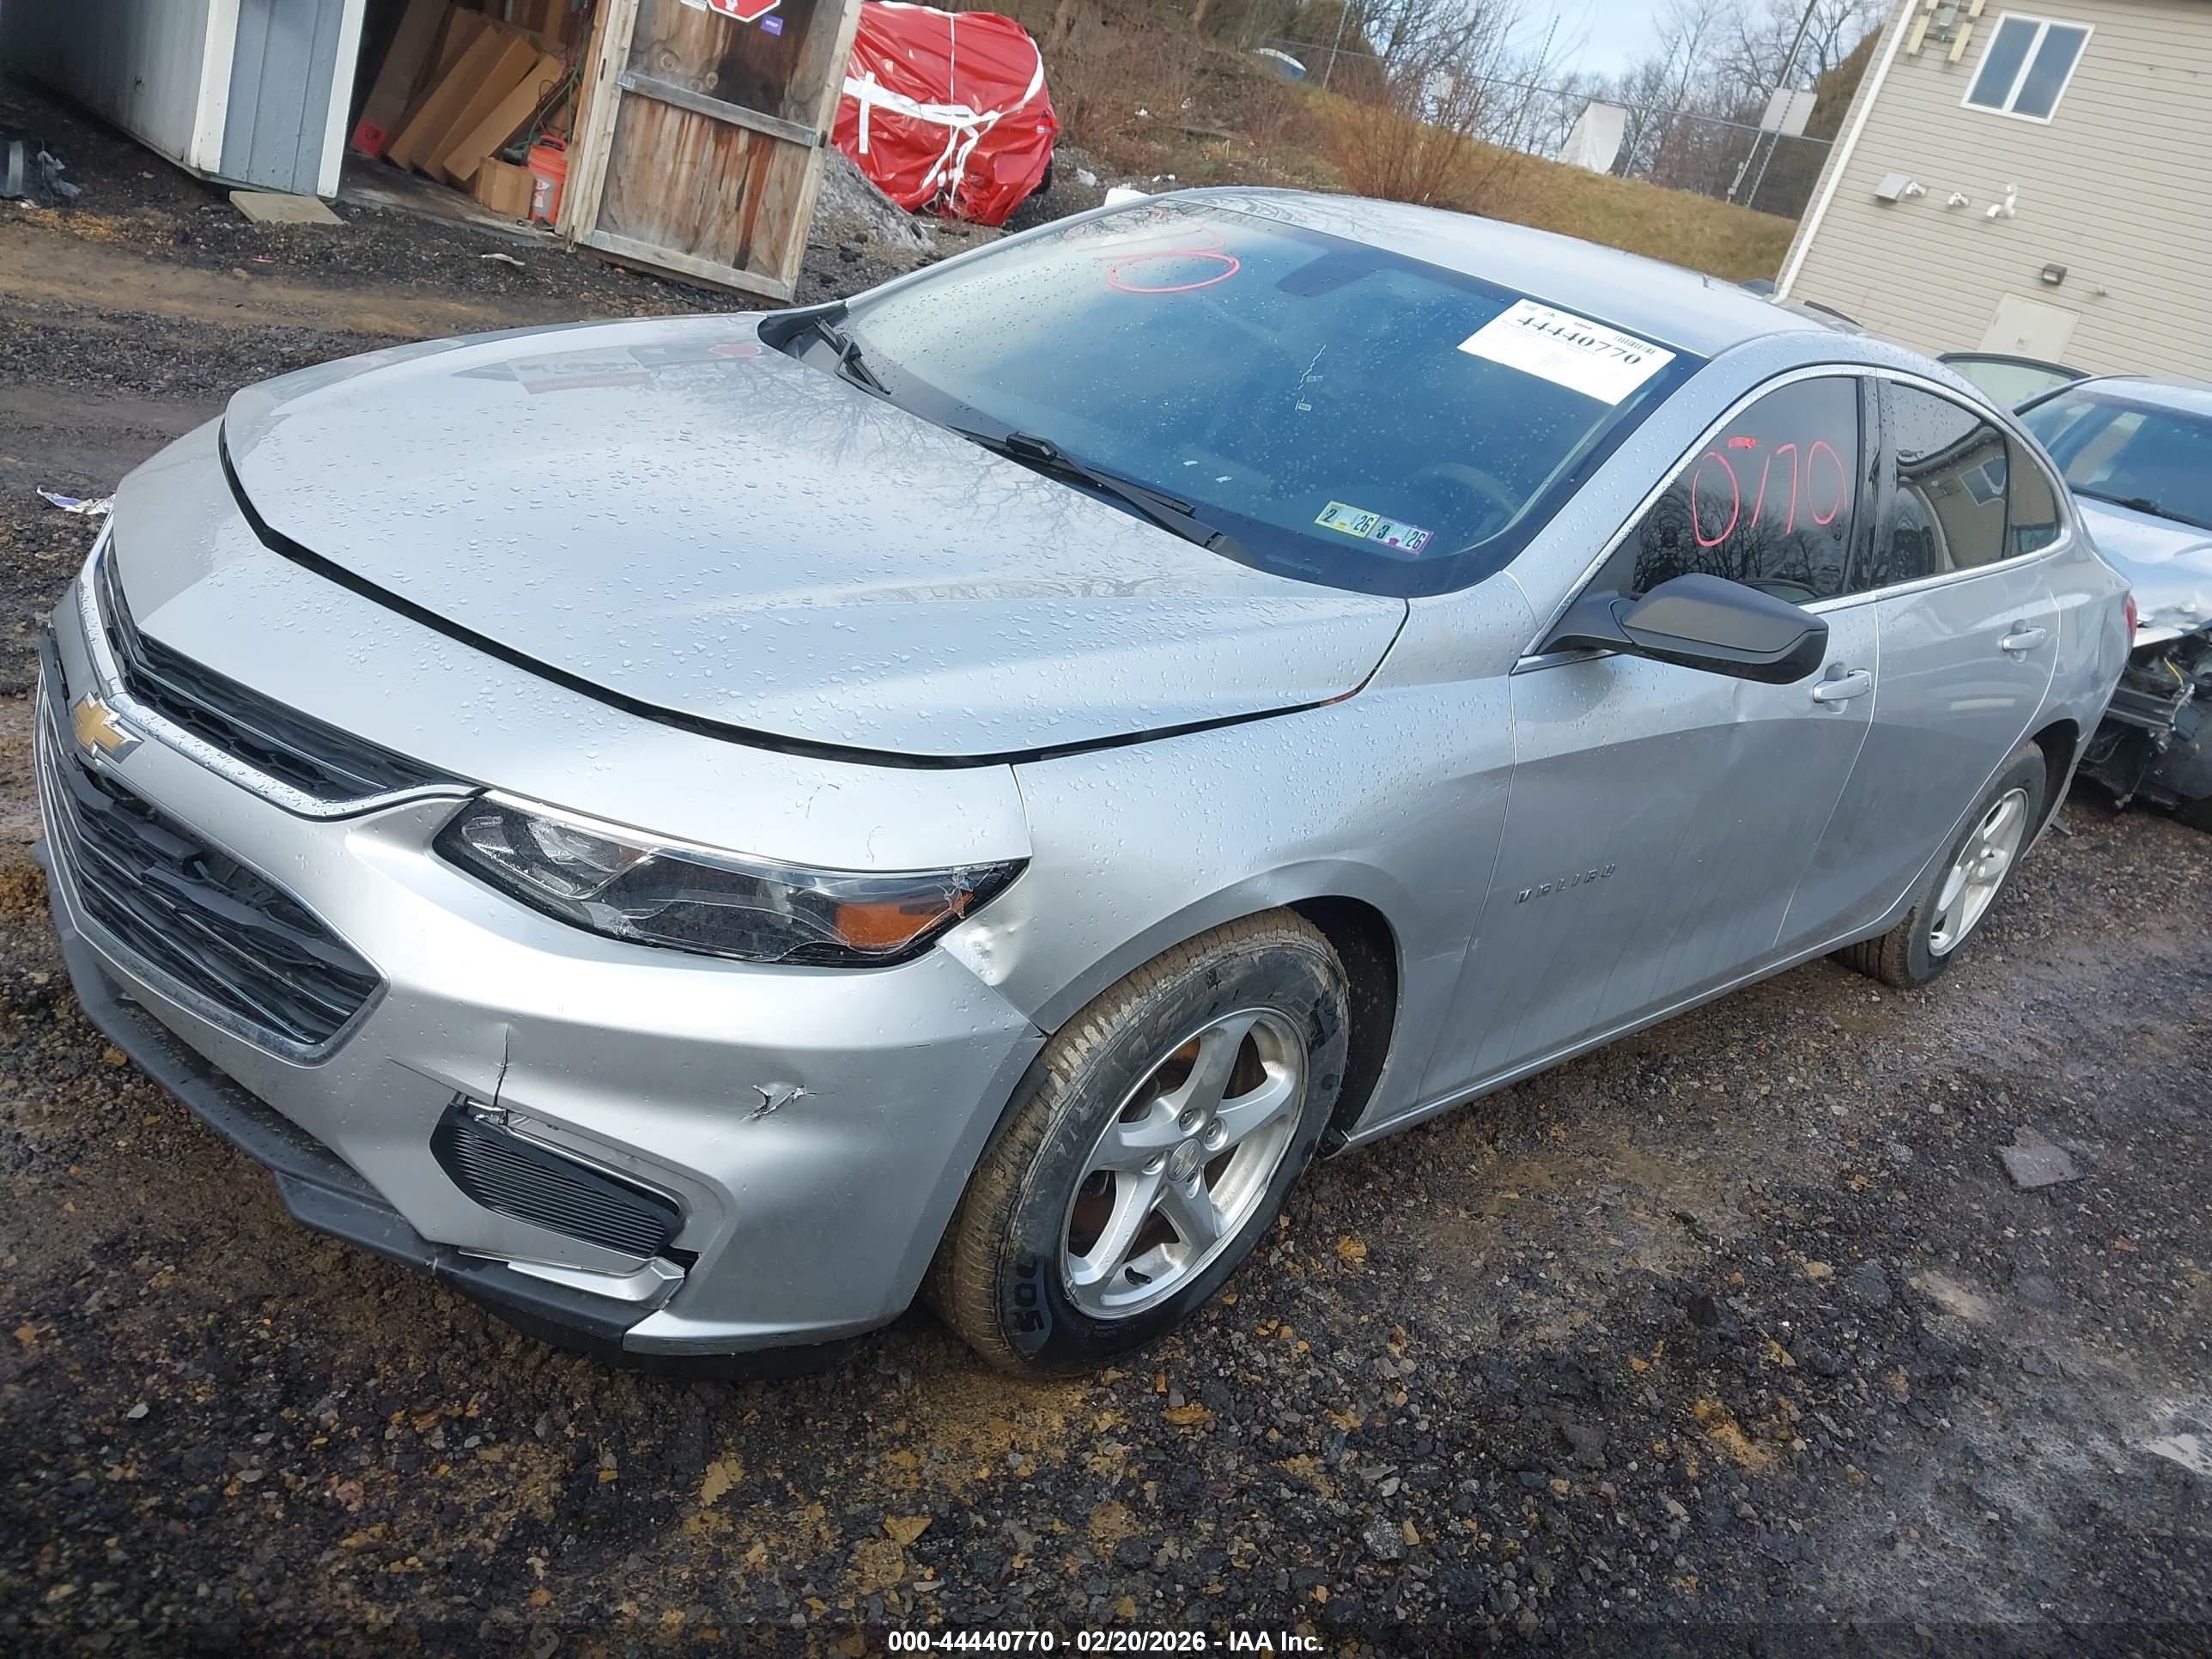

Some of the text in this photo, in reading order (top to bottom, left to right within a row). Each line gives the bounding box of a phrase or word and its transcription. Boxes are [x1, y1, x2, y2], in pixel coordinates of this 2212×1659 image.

[1516, 316, 1643, 366] 44440770
[1322, 508, 1374, 533] 2 26
[1376, 525, 1426, 550] 3 26
